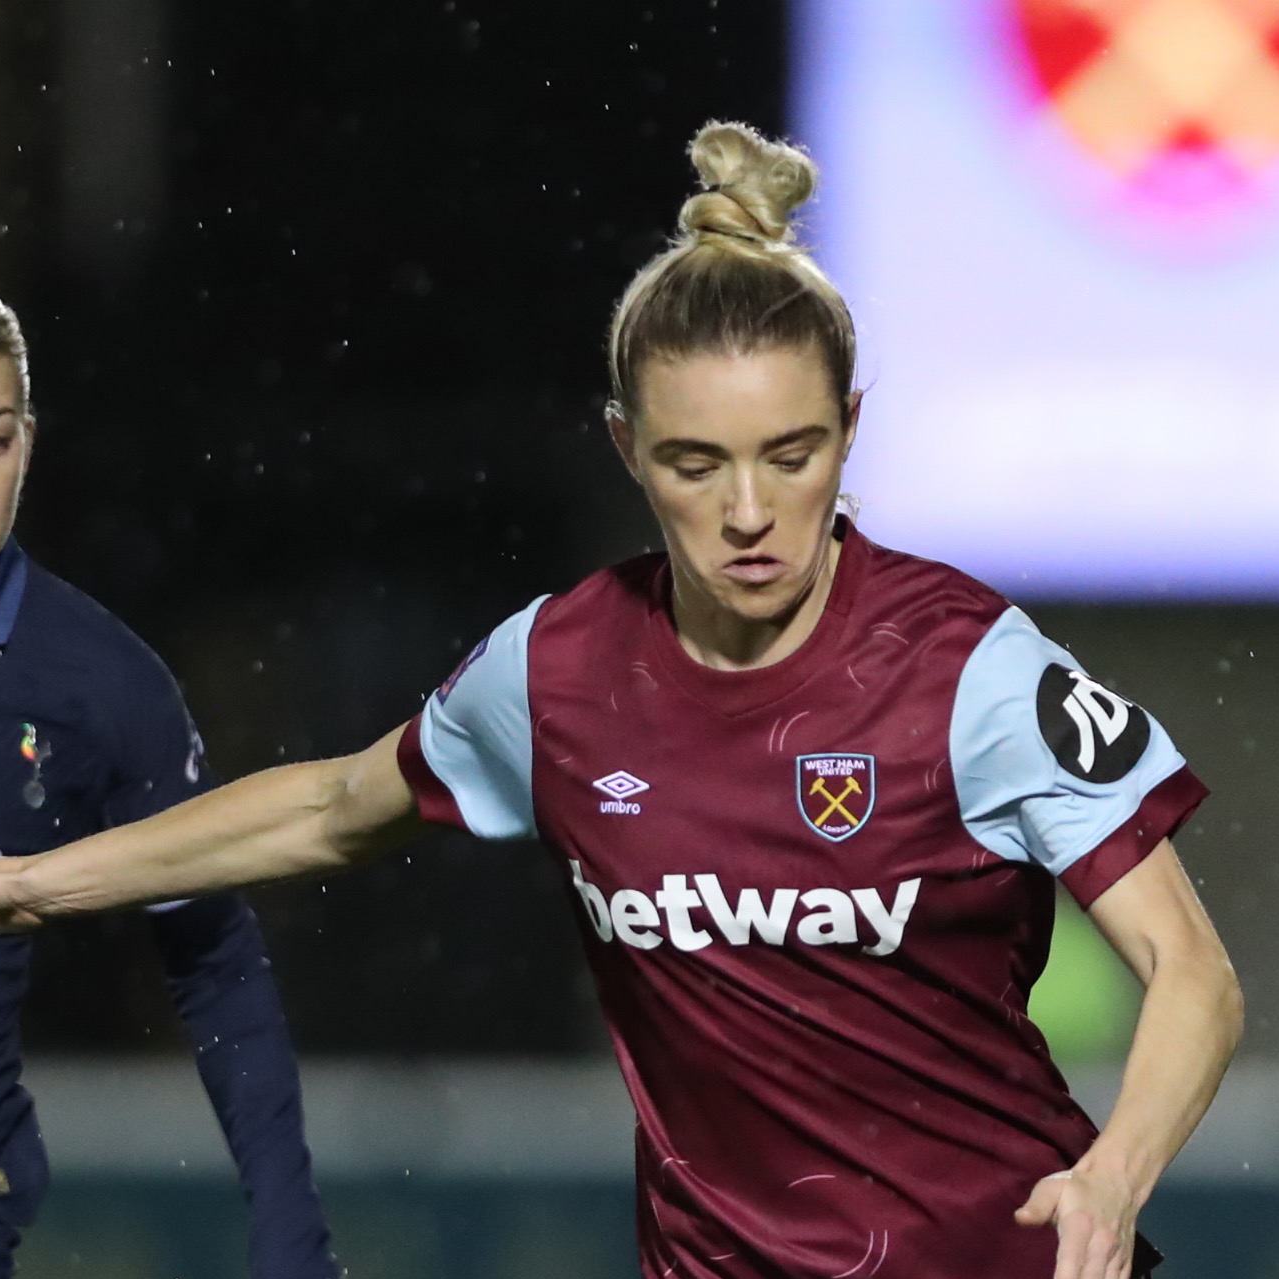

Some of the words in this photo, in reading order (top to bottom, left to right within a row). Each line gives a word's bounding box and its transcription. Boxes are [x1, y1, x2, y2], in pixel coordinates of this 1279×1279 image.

[1062, 672, 1131, 773] JD
[805, 759, 836, 770] WEST
[837, 759, 865, 770] HAM
[817, 767, 853, 775] UNITED
[600, 800, 641, 815] umbro
[822, 824, 851, 833] LONDON
[569, 858, 922, 957] betway
